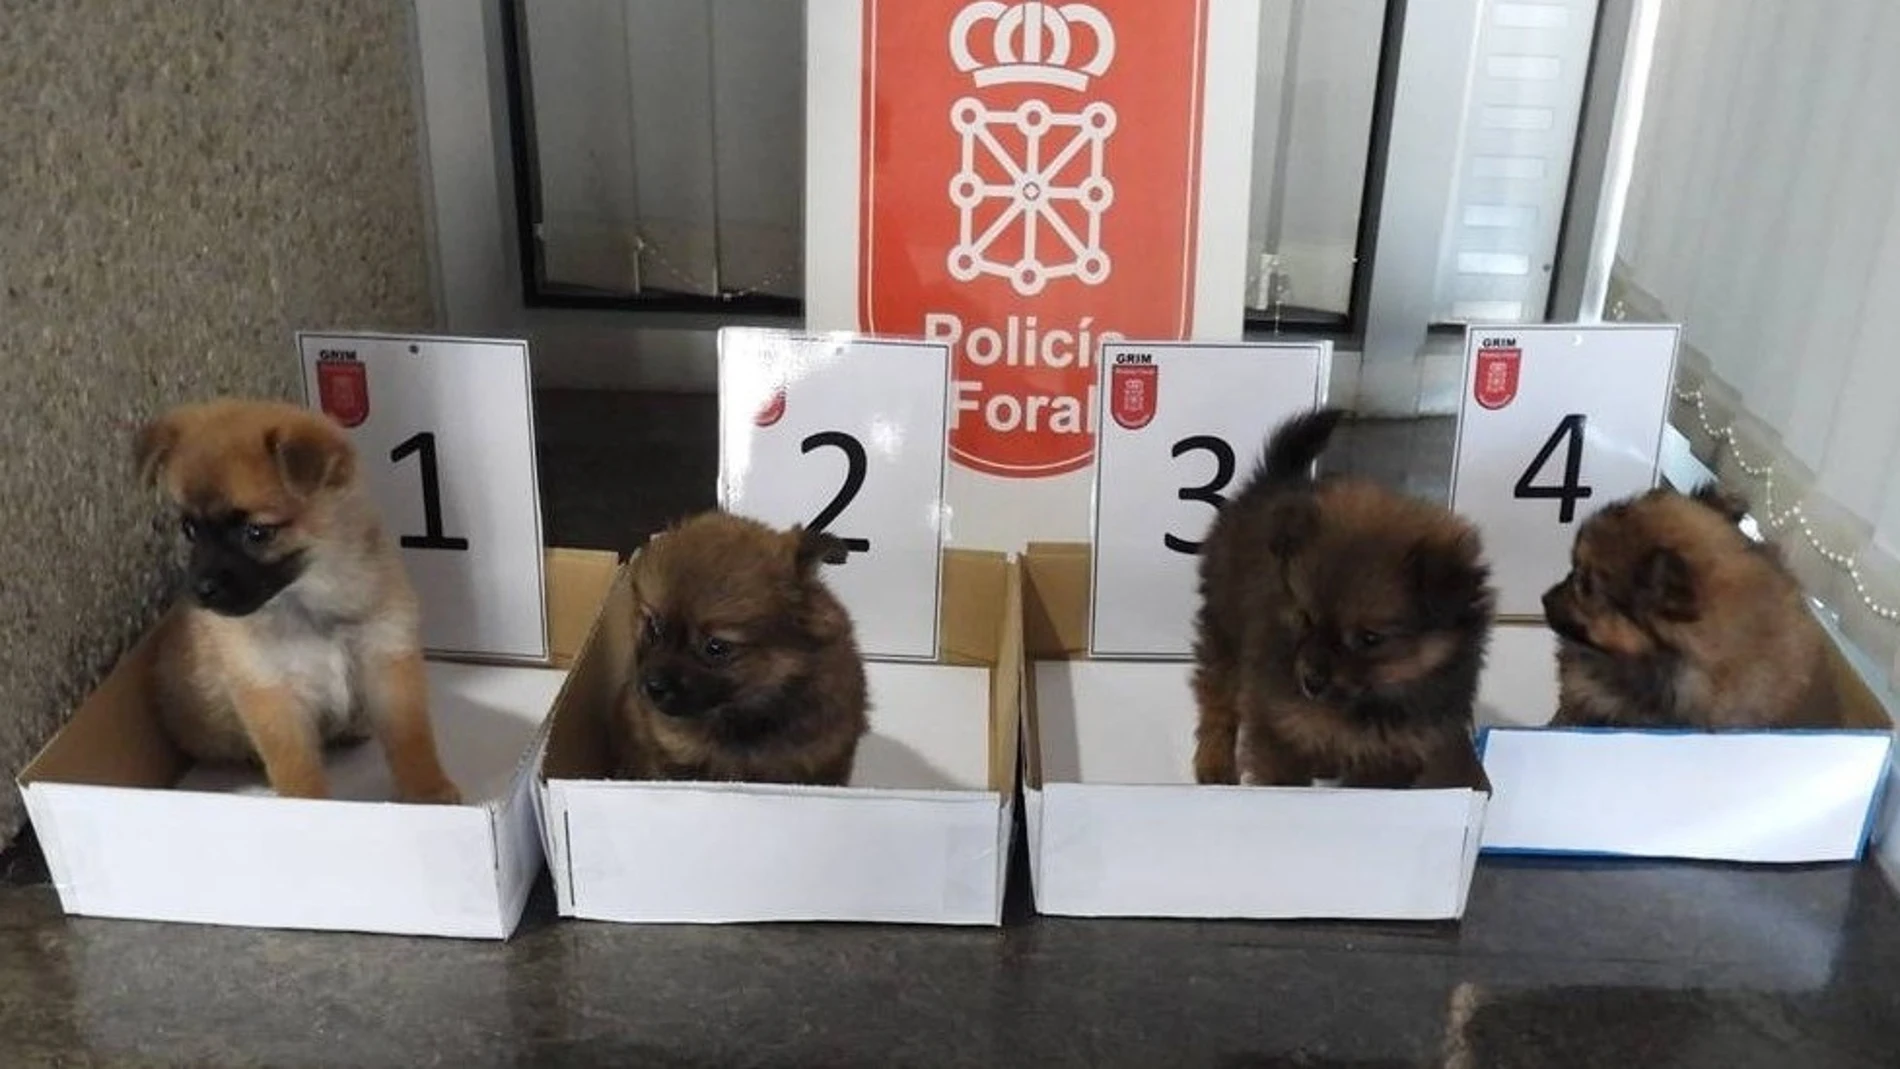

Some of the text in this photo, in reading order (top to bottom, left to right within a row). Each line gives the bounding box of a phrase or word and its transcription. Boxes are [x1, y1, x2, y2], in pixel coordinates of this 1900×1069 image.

[1115, 353, 1153, 364] GRIM
[1482, 337, 1517, 347] GRIM
[950, 381, 1098, 433] Foral
[391, 431, 469, 551] 1
[801, 431, 870, 553] 2
[1164, 435, 1236, 555] 3
[1514, 414, 1592, 523] 4
